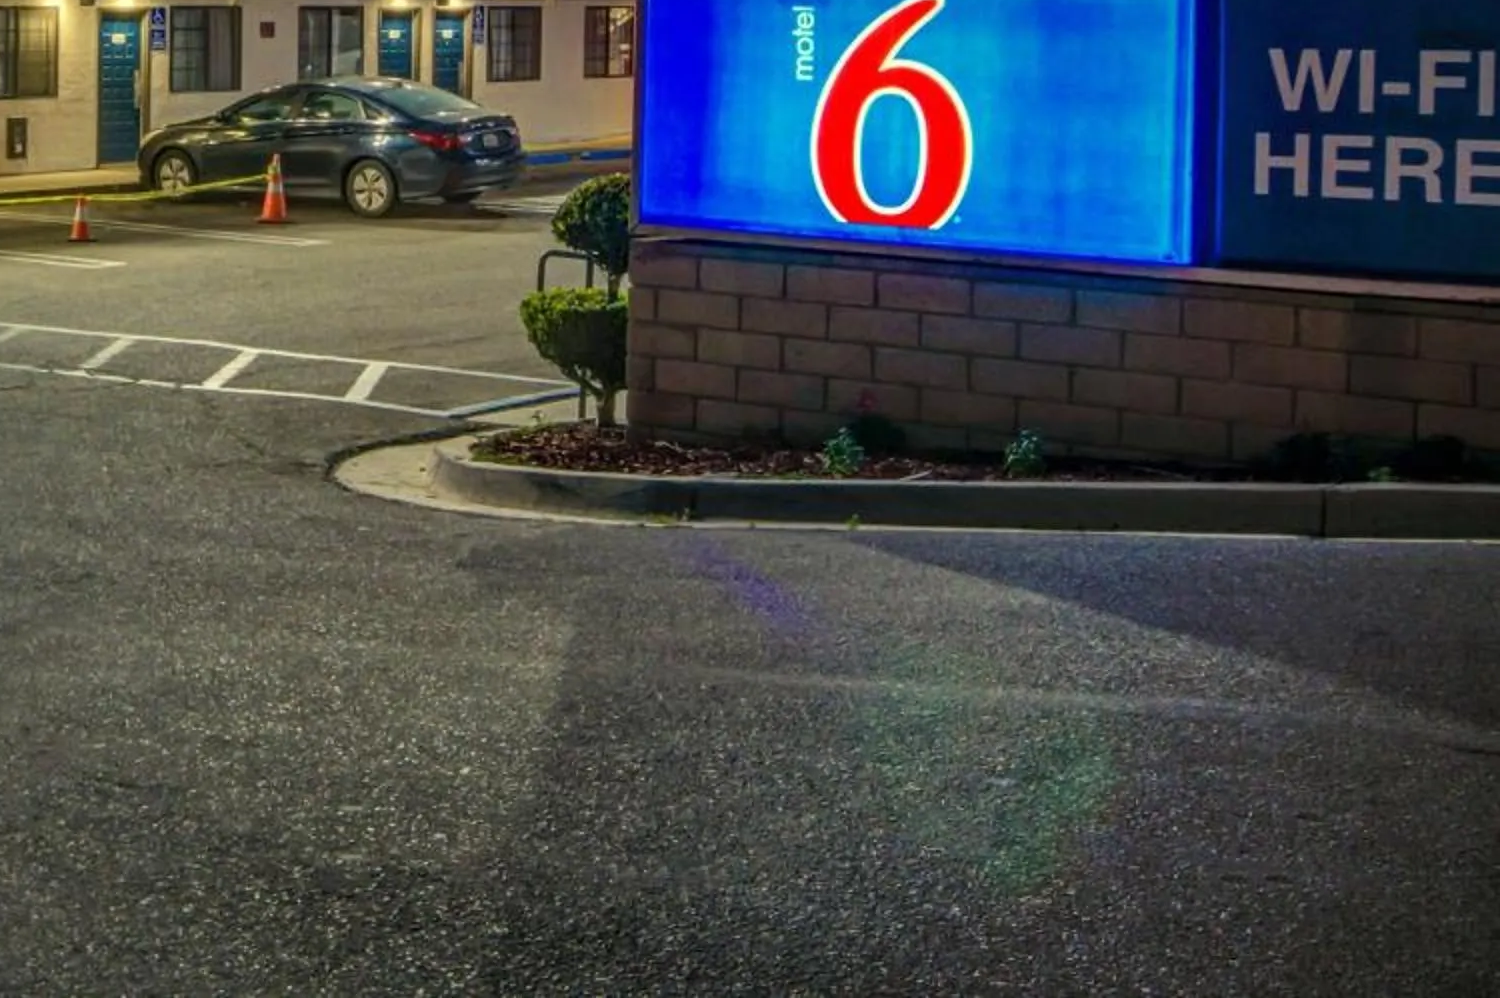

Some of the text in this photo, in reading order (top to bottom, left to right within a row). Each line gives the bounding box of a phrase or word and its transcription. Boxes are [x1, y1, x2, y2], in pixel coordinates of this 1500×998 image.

[791, 5, 816, 82] motel
[1267, 47, 1496, 117] WI-FI
[1254, 131, 1500, 207] HERE
